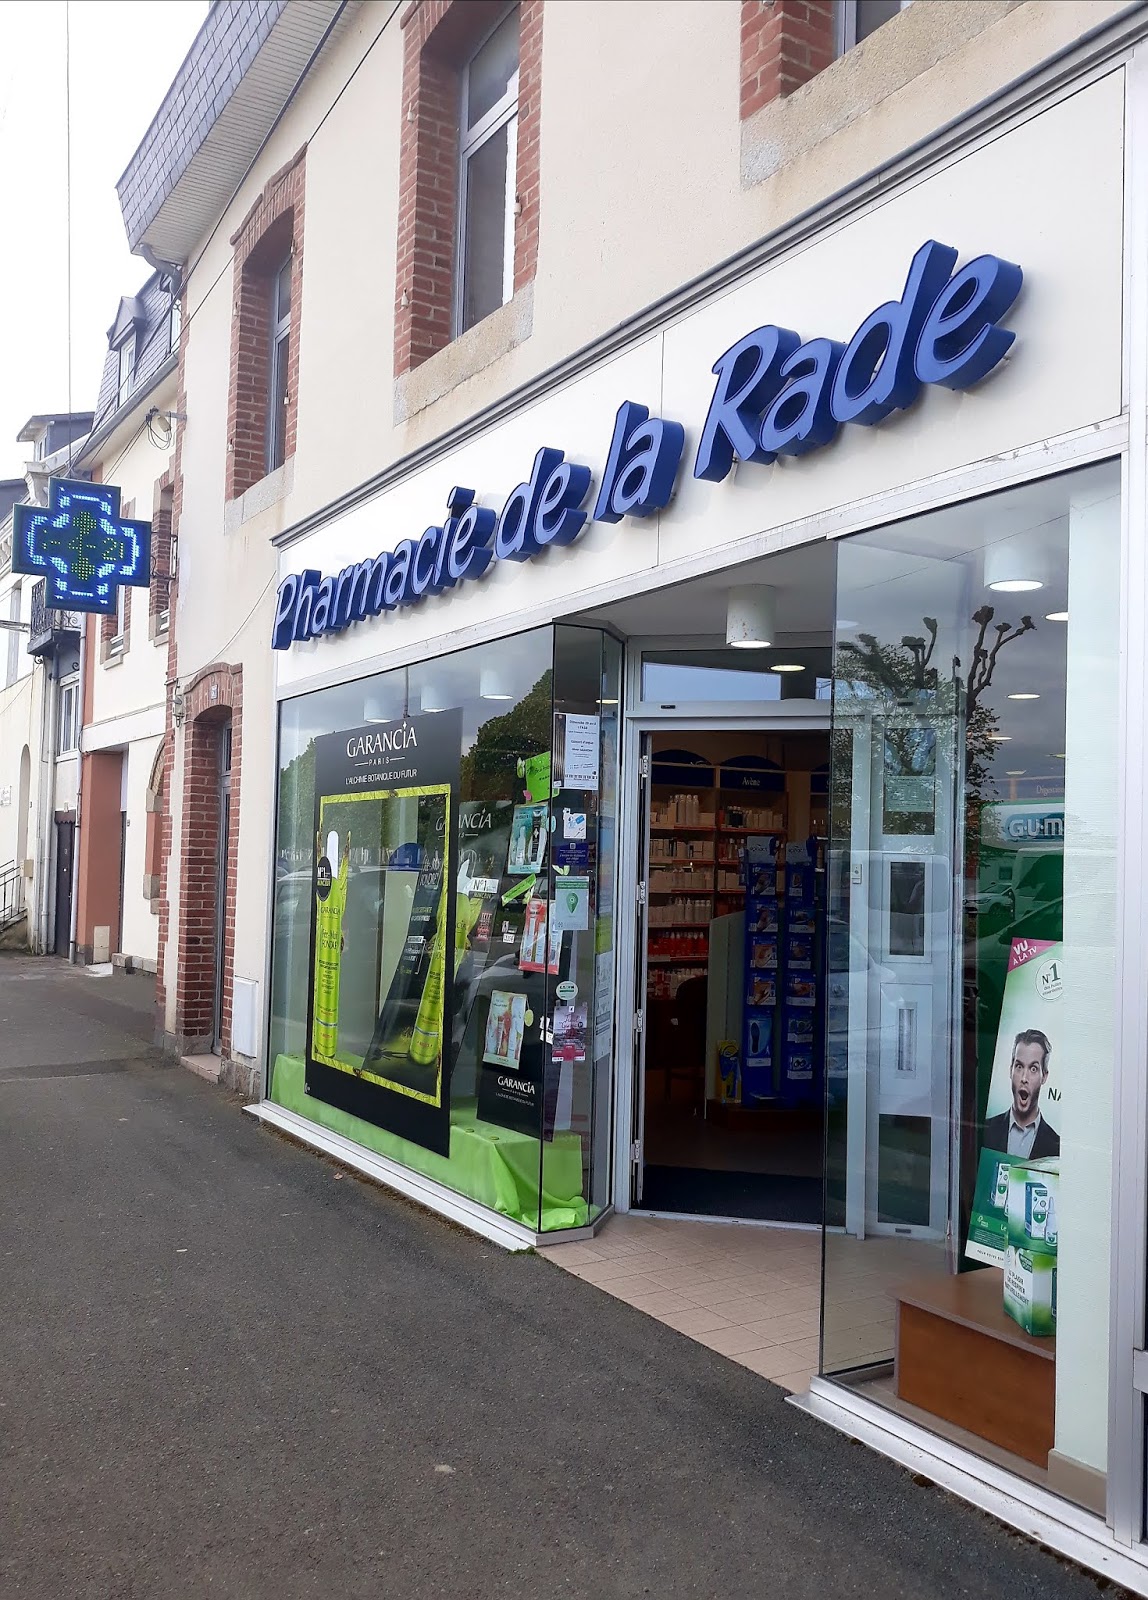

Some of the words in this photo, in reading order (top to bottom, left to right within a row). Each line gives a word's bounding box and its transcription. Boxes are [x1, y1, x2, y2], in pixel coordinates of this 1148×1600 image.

[271, 486, 496, 651] Pharmacie
[495, 446, 592, 563] de
[593, 399, 685, 524] la
[693, 239, 1024, 482] Rade
[368, 756, 390, 767] PARIS
[393, 771, 400, 780] DU
[400, 769, 418, 779] FUTUR
[1012, 939, 1029, 956] VU
[1018, 952, 1028, 962] LA
[1028, 945, 1037, 956] TV
